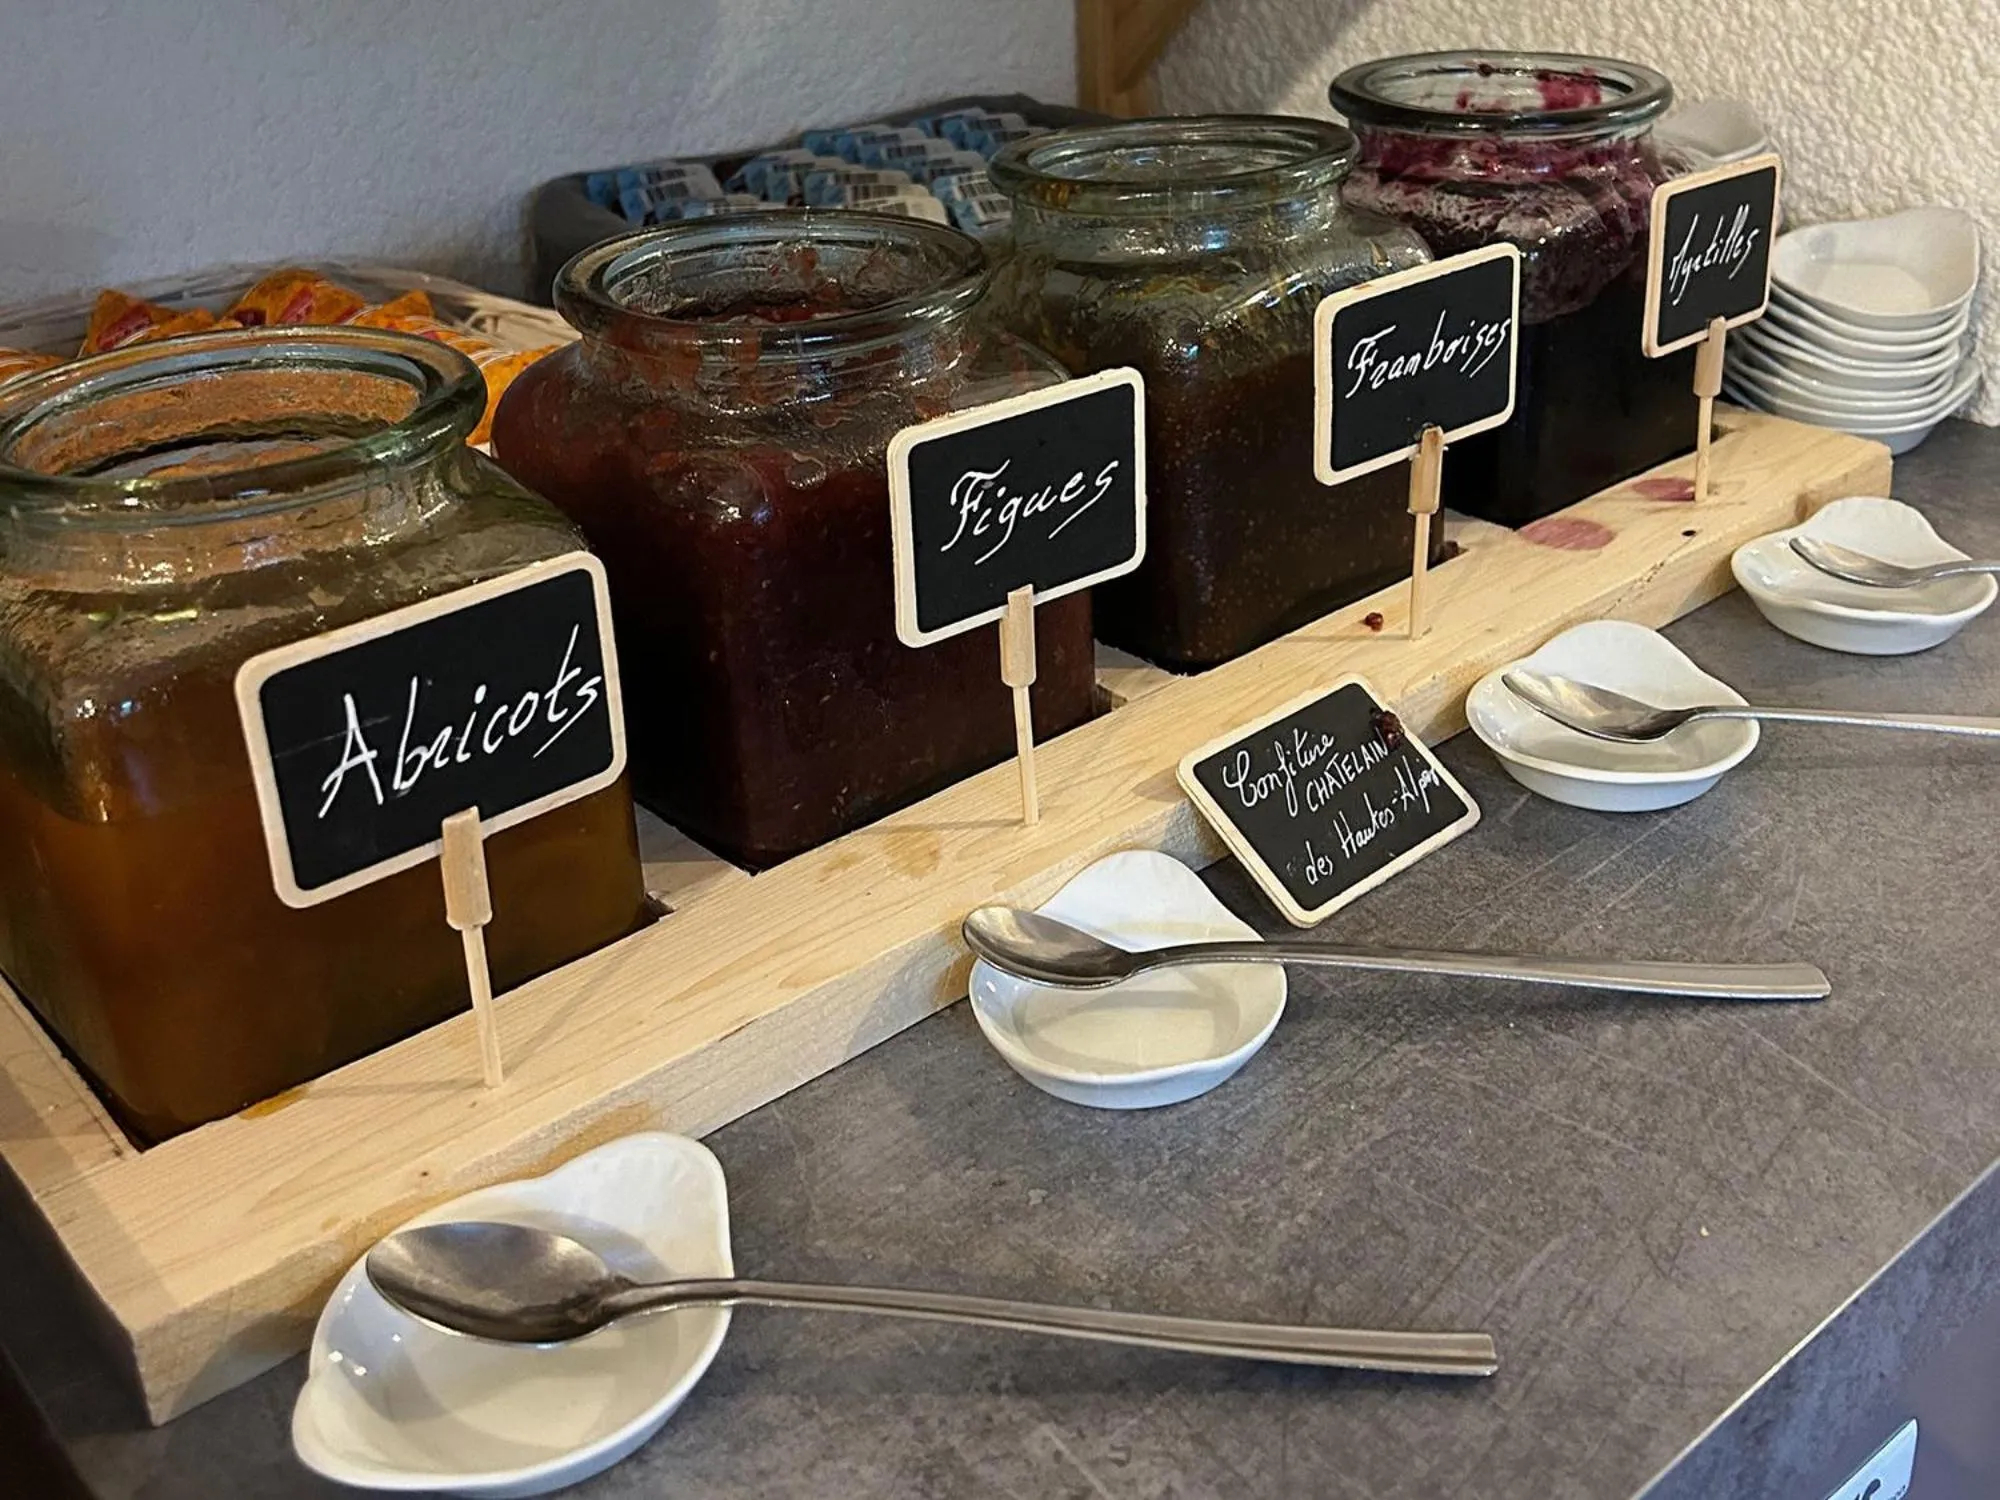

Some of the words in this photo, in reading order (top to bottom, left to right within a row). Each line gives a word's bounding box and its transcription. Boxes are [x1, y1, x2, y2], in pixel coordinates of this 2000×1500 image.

[1345, 309, 1512, 399] Framboises
[940, 458, 1120, 566] Figues
[317, 623, 602, 819] Abricots
[1222, 727, 1335, 818] Confiture
[1305, 840, 1334, 886] des
